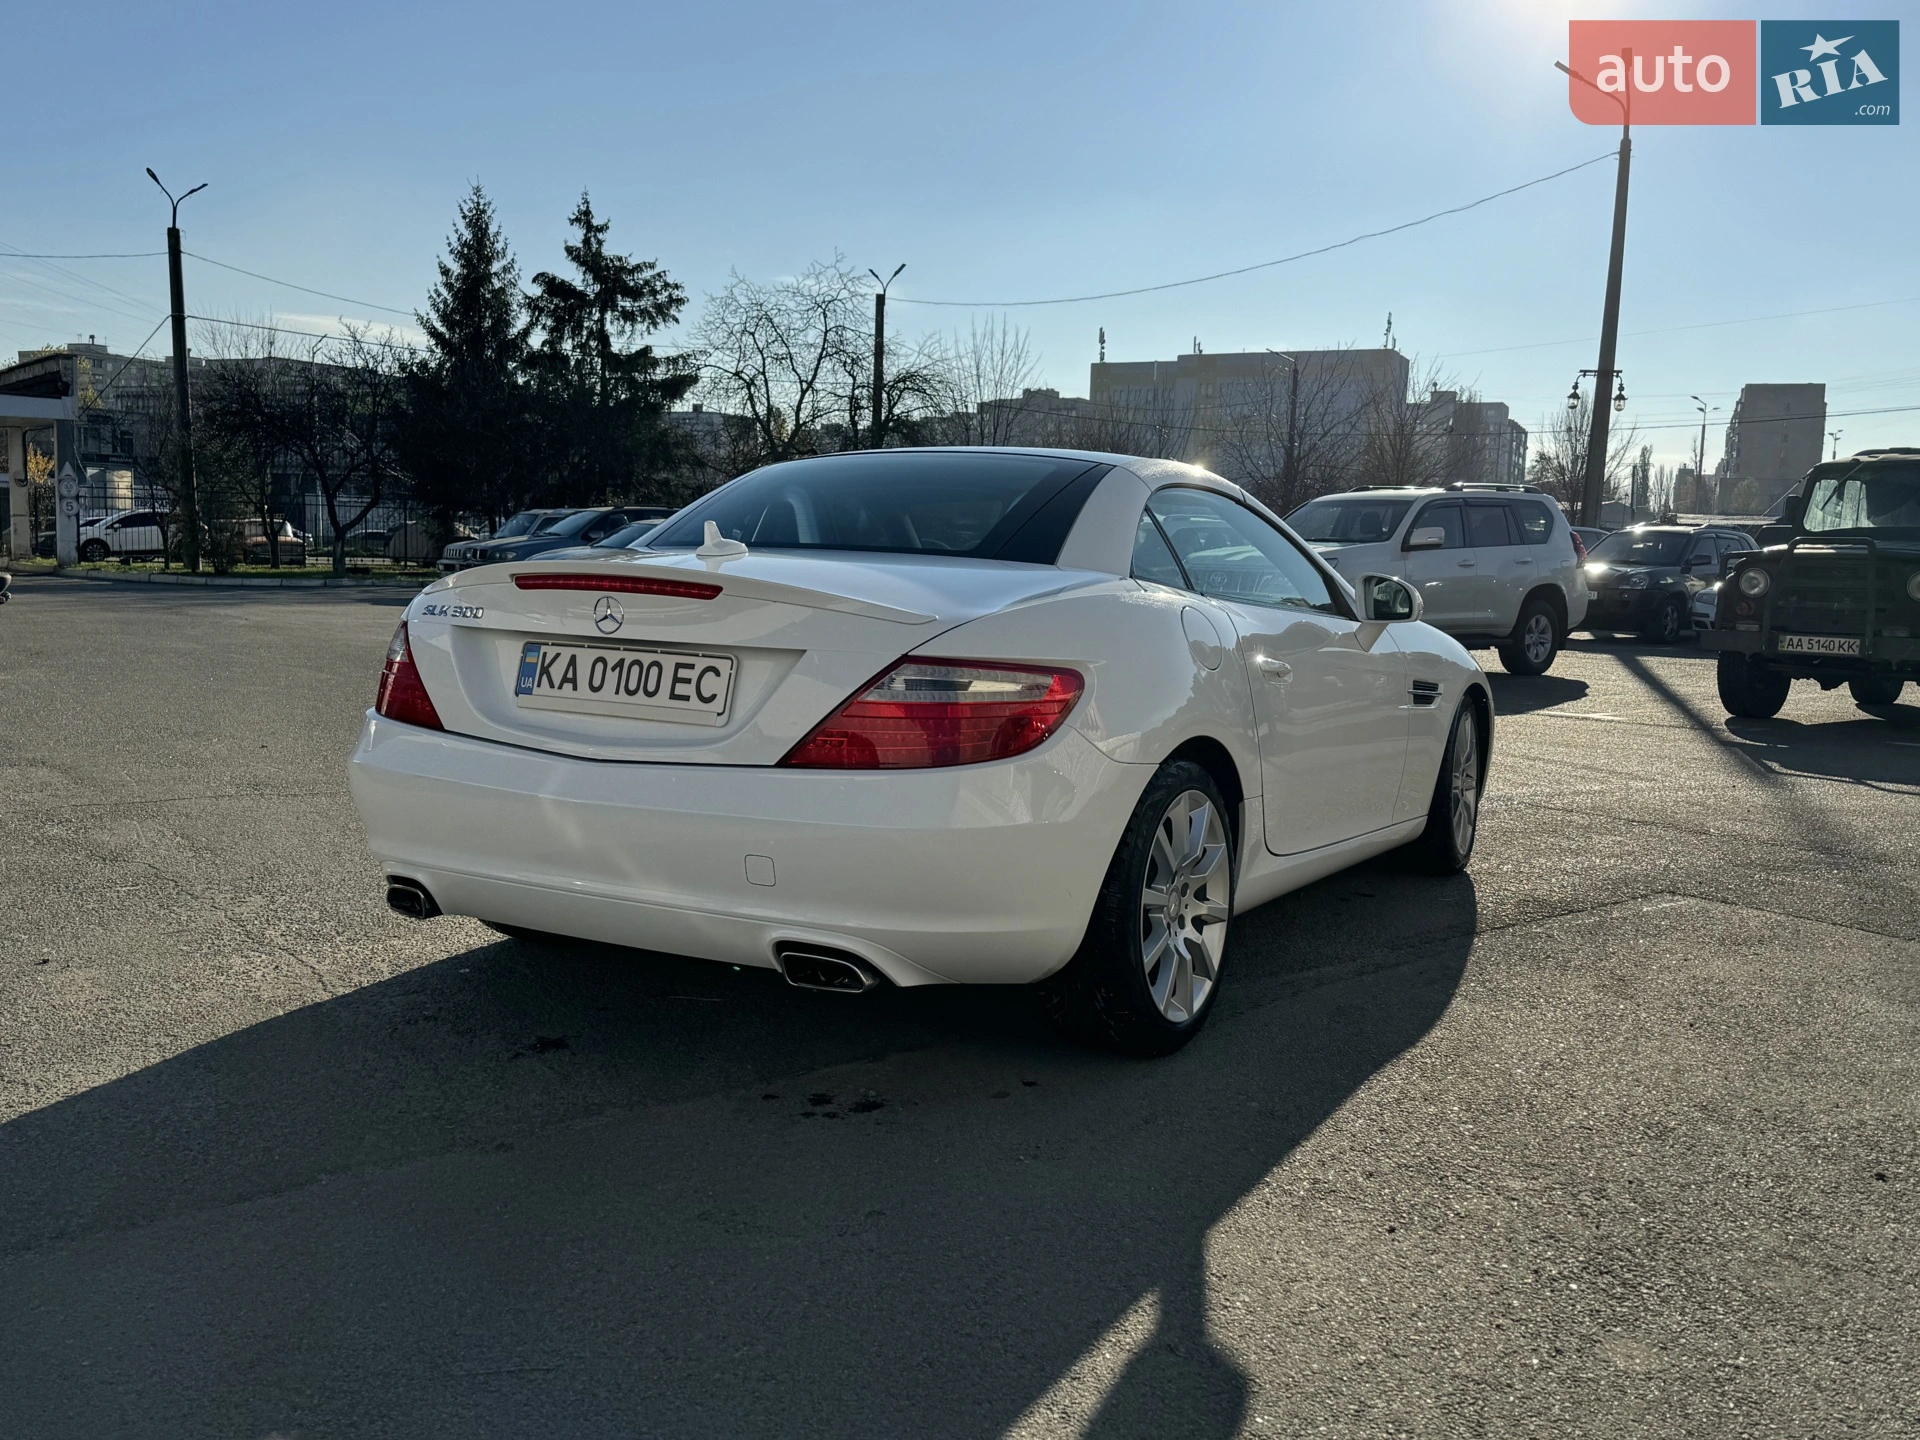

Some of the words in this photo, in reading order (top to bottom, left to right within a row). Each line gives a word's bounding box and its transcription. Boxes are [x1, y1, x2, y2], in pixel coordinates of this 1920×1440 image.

[66, 501, 74, 511] 5
[421, 604, 451, 618] SLK
[451, 605, 485, 619] 300
[1786, 637, 1804, 650] AA
[1807, 638, 1836, 652] 5140
[1837, 639, 1857, 653] KK
[520, 676, 533, 689] UA
[536, 651, 579, 692] KA
[588, 655, 664, 698] 0100
[668, 661, 722, 704] EC
